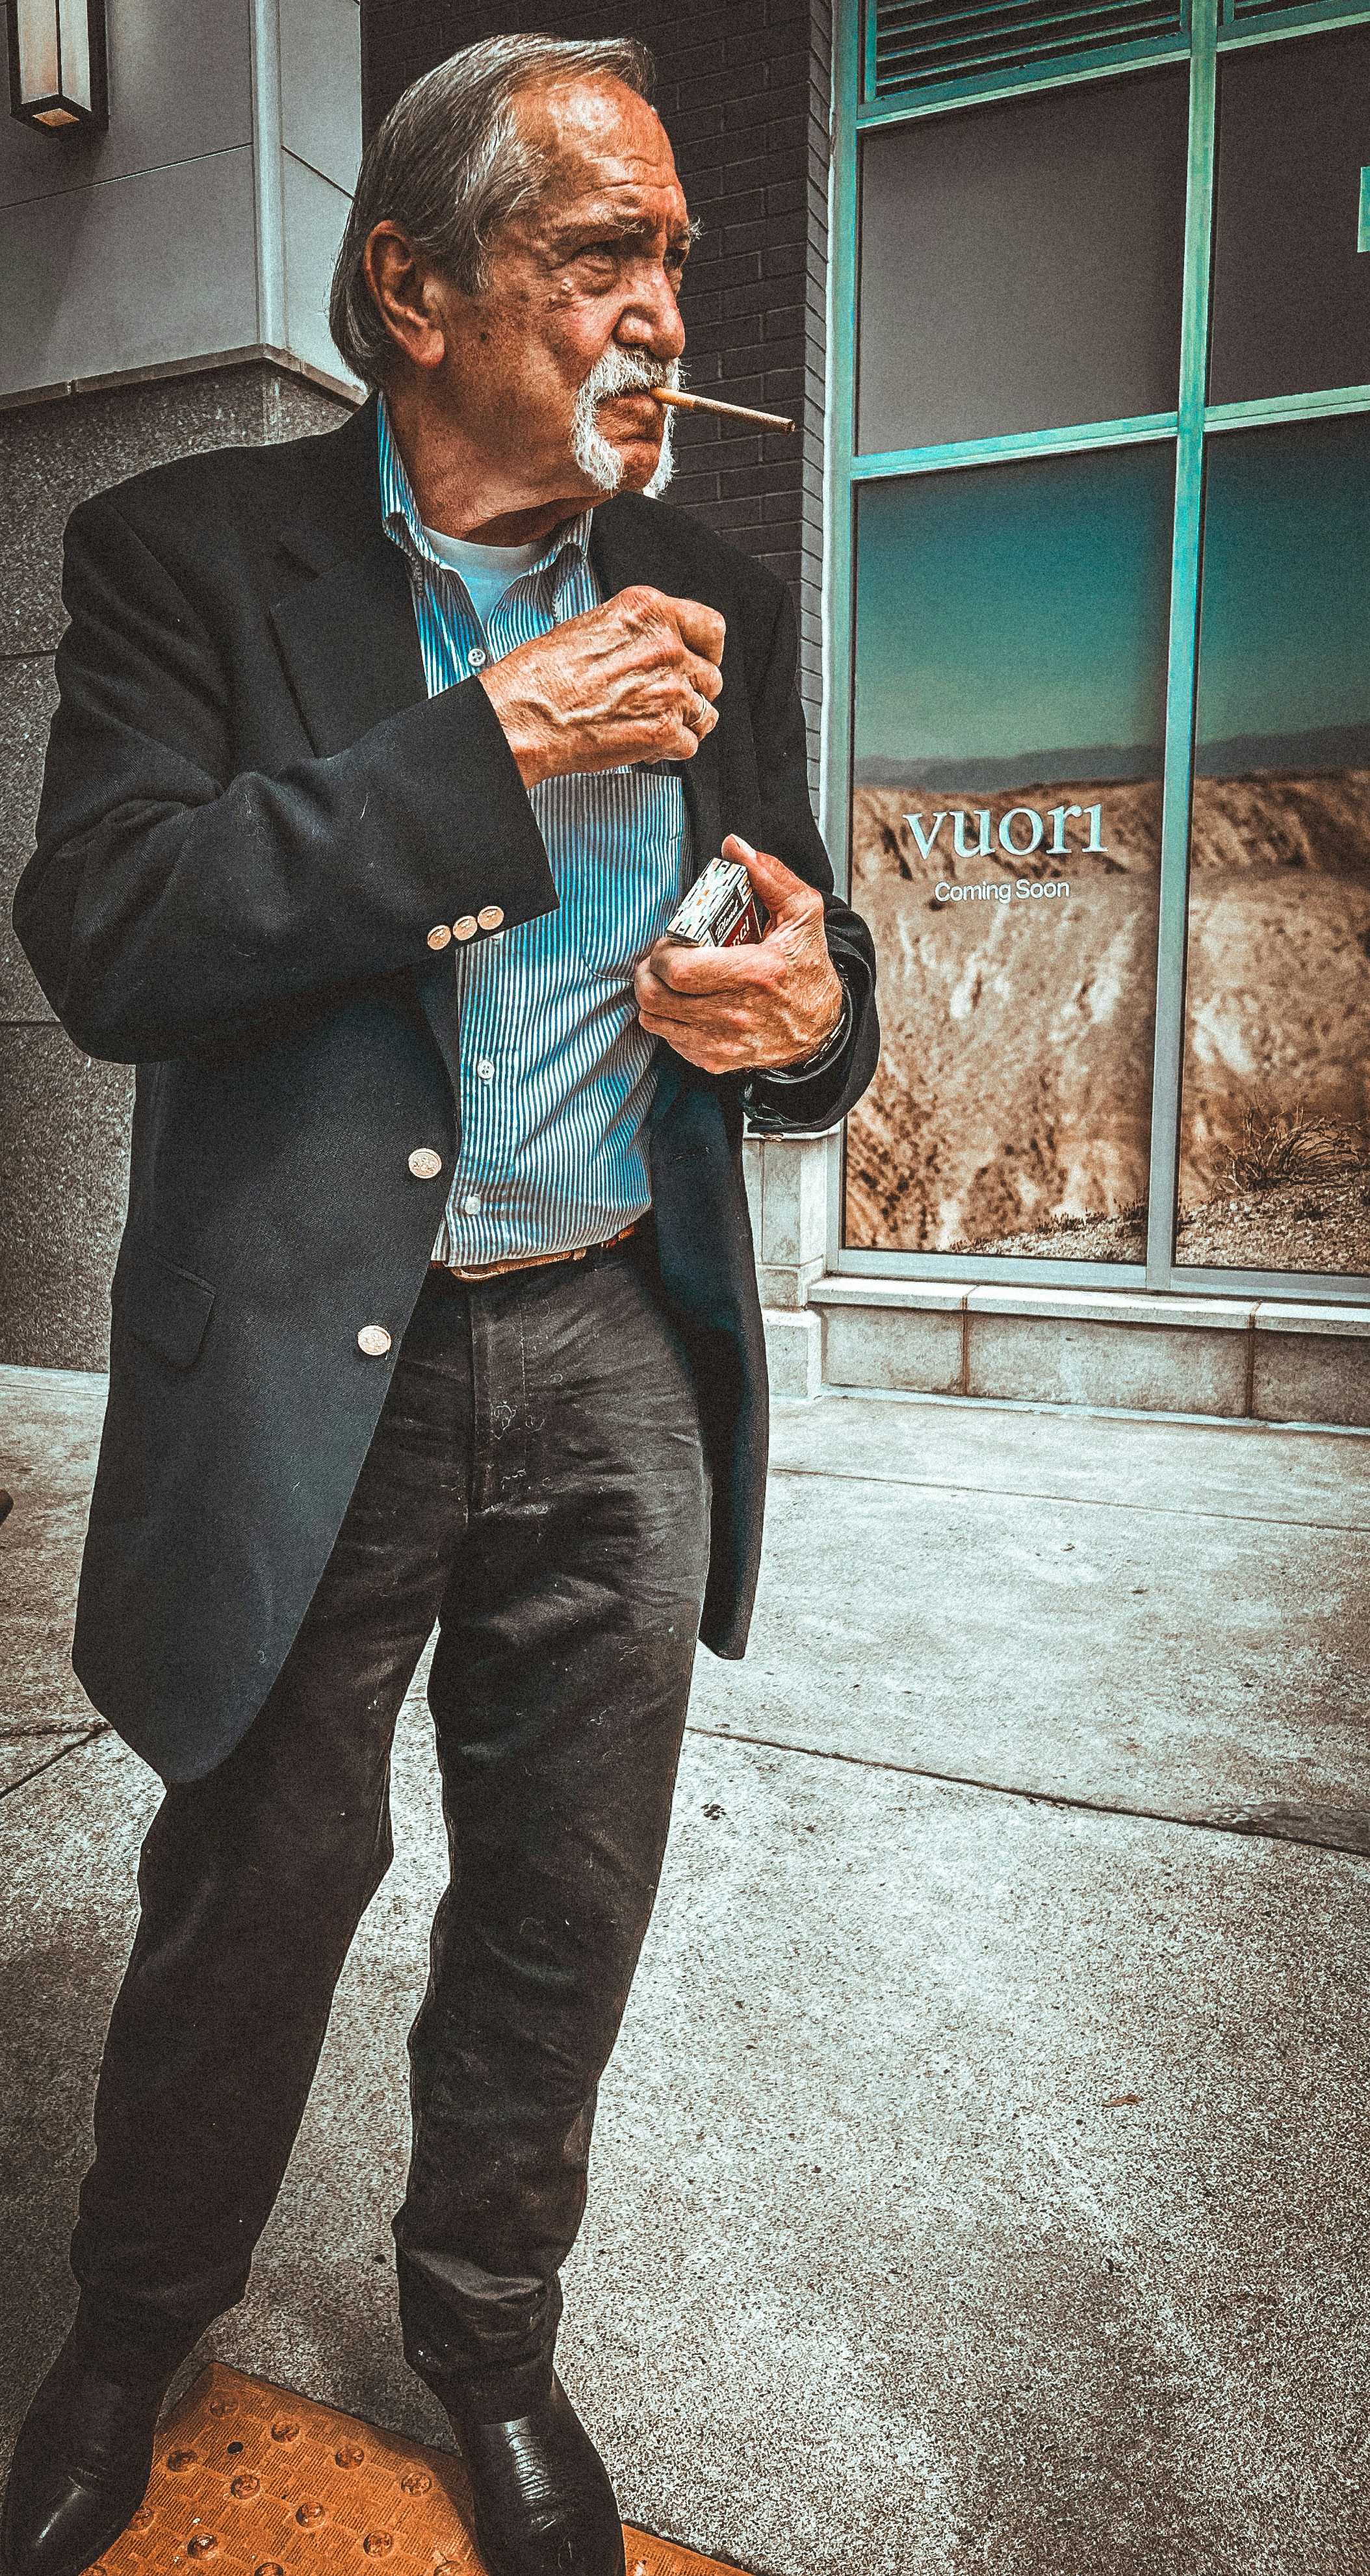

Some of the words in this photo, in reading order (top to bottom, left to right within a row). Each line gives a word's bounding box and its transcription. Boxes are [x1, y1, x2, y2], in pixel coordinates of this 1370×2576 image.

[902, 803, 1109, 859] vuori
[935, 881, 1011, 904] Coming
[1016, 879, 1070, 899] Soon
